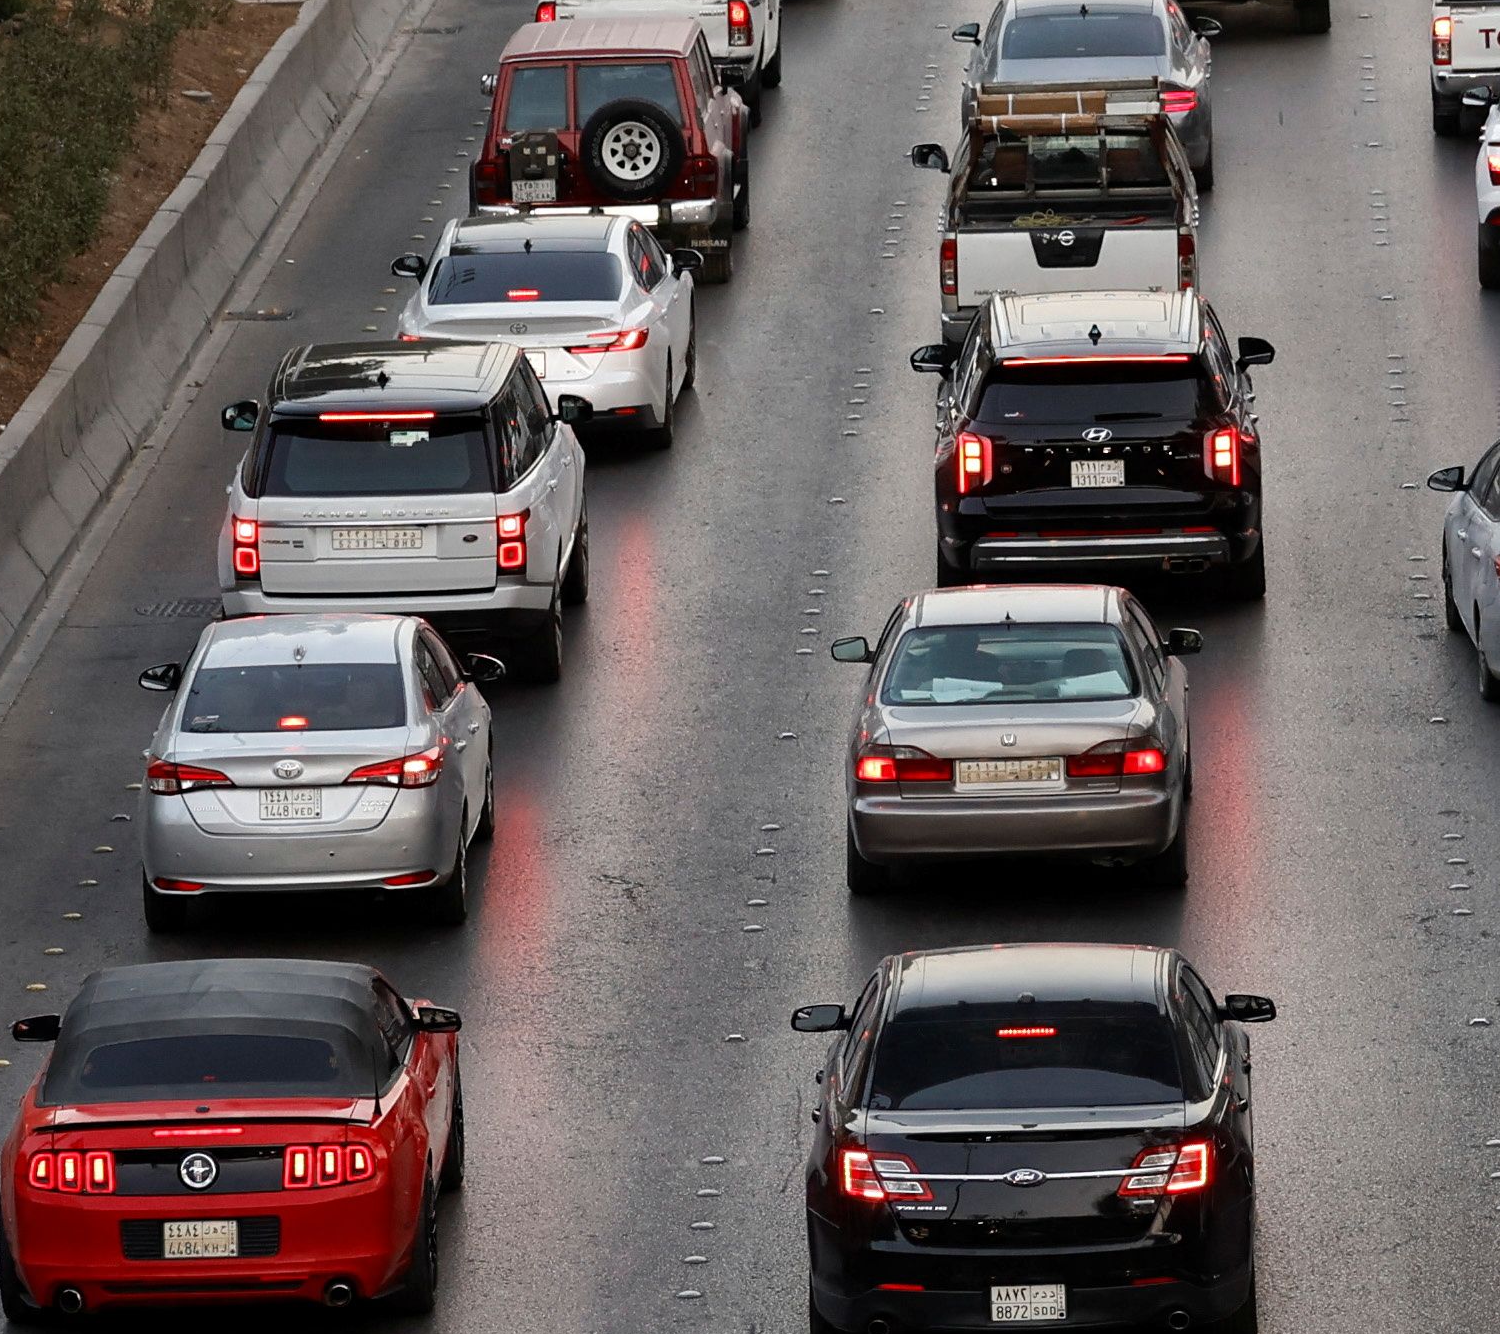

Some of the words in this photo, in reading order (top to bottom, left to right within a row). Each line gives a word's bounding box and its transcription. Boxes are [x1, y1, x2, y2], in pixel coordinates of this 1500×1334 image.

[691, 239, 728, 248] NISSAN
[1075, 475, 1097, 486] 1311
[302, 510, 368, 518] RANGE
[382, 508, 449, 517] ROVER
[264, 791, 288, 803] ١٤٤٨
[264, 805, 289, 816] 1448
[294, 807, 313, 816] VED
[168, 1224, 199, 1238] ٤٤٨٤
[168, 1241, 200, 1255] 4484
[203, 1243, 227, 1253] KHJ
[996, 1288, 1027, 1302] ٨٨٧٢
[996, 1305, 1028, 1319] 8872
